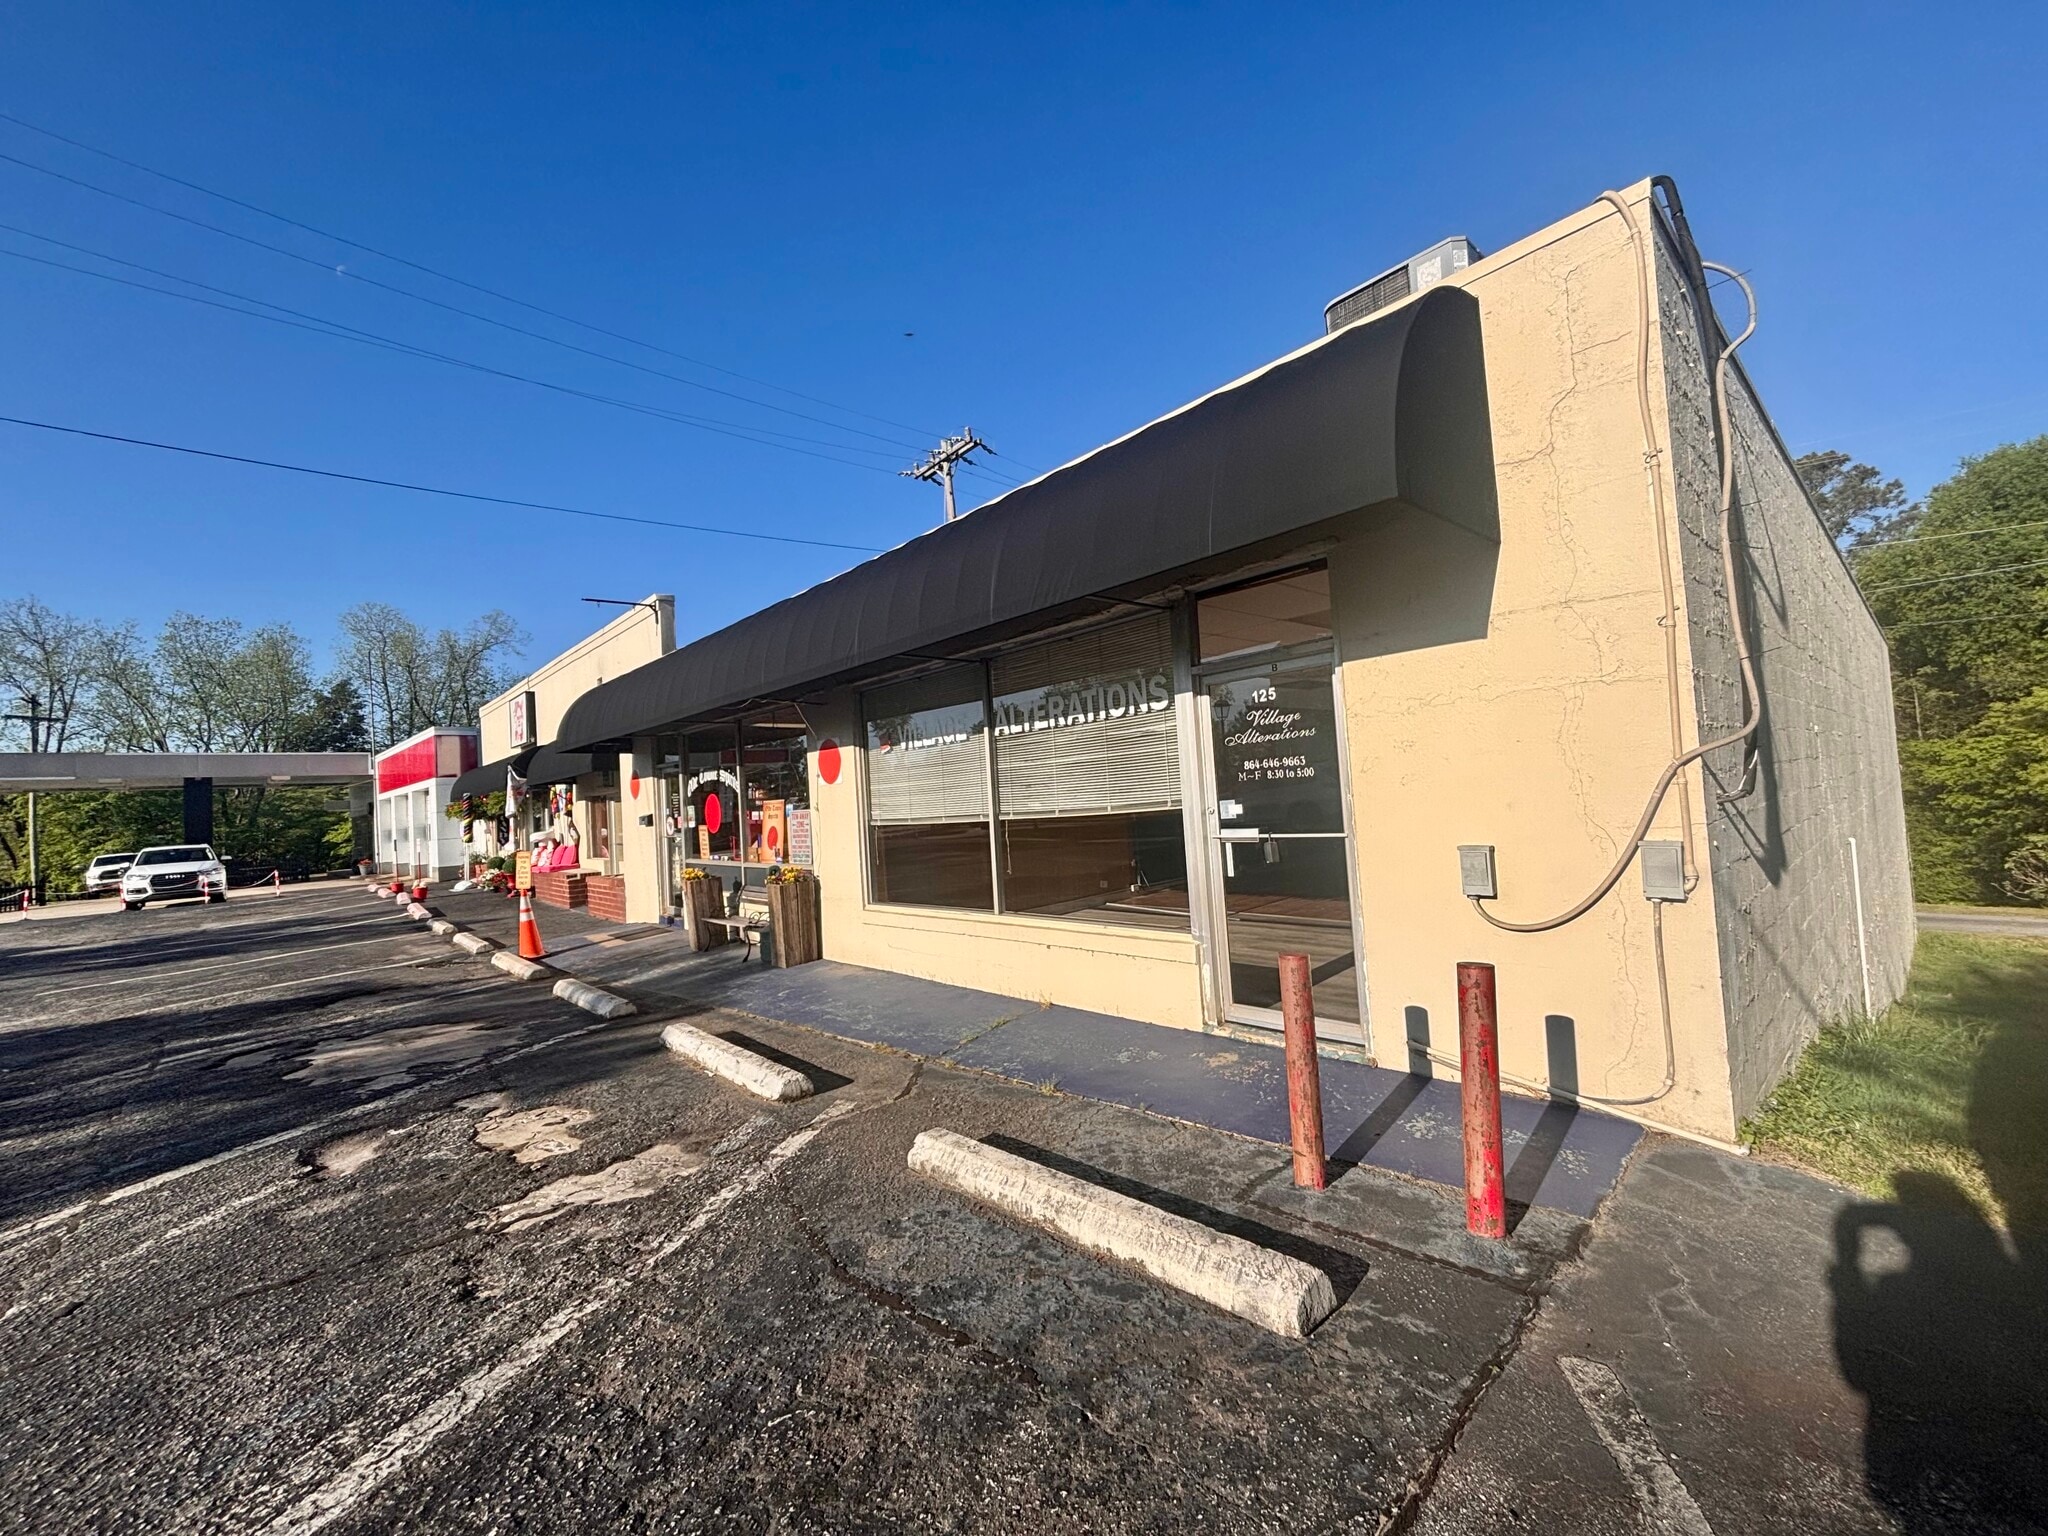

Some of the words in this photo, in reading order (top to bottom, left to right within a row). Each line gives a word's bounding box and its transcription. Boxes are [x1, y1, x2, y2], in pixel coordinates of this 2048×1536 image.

[1252, 687, 1276, 703] 125
[994, 674, 1169, 736] ALTERATIONS
[1246, 708, 1301, 728] Village
[1224, 727, 1316, 746] Alterations
[1243, 756, 1306, 770] 864-646-9663
[1266, 769, 1284, 779] 8:30
[1285, 768, 1295, 778] to
[1296, 767, 1315, 777] 5:00
